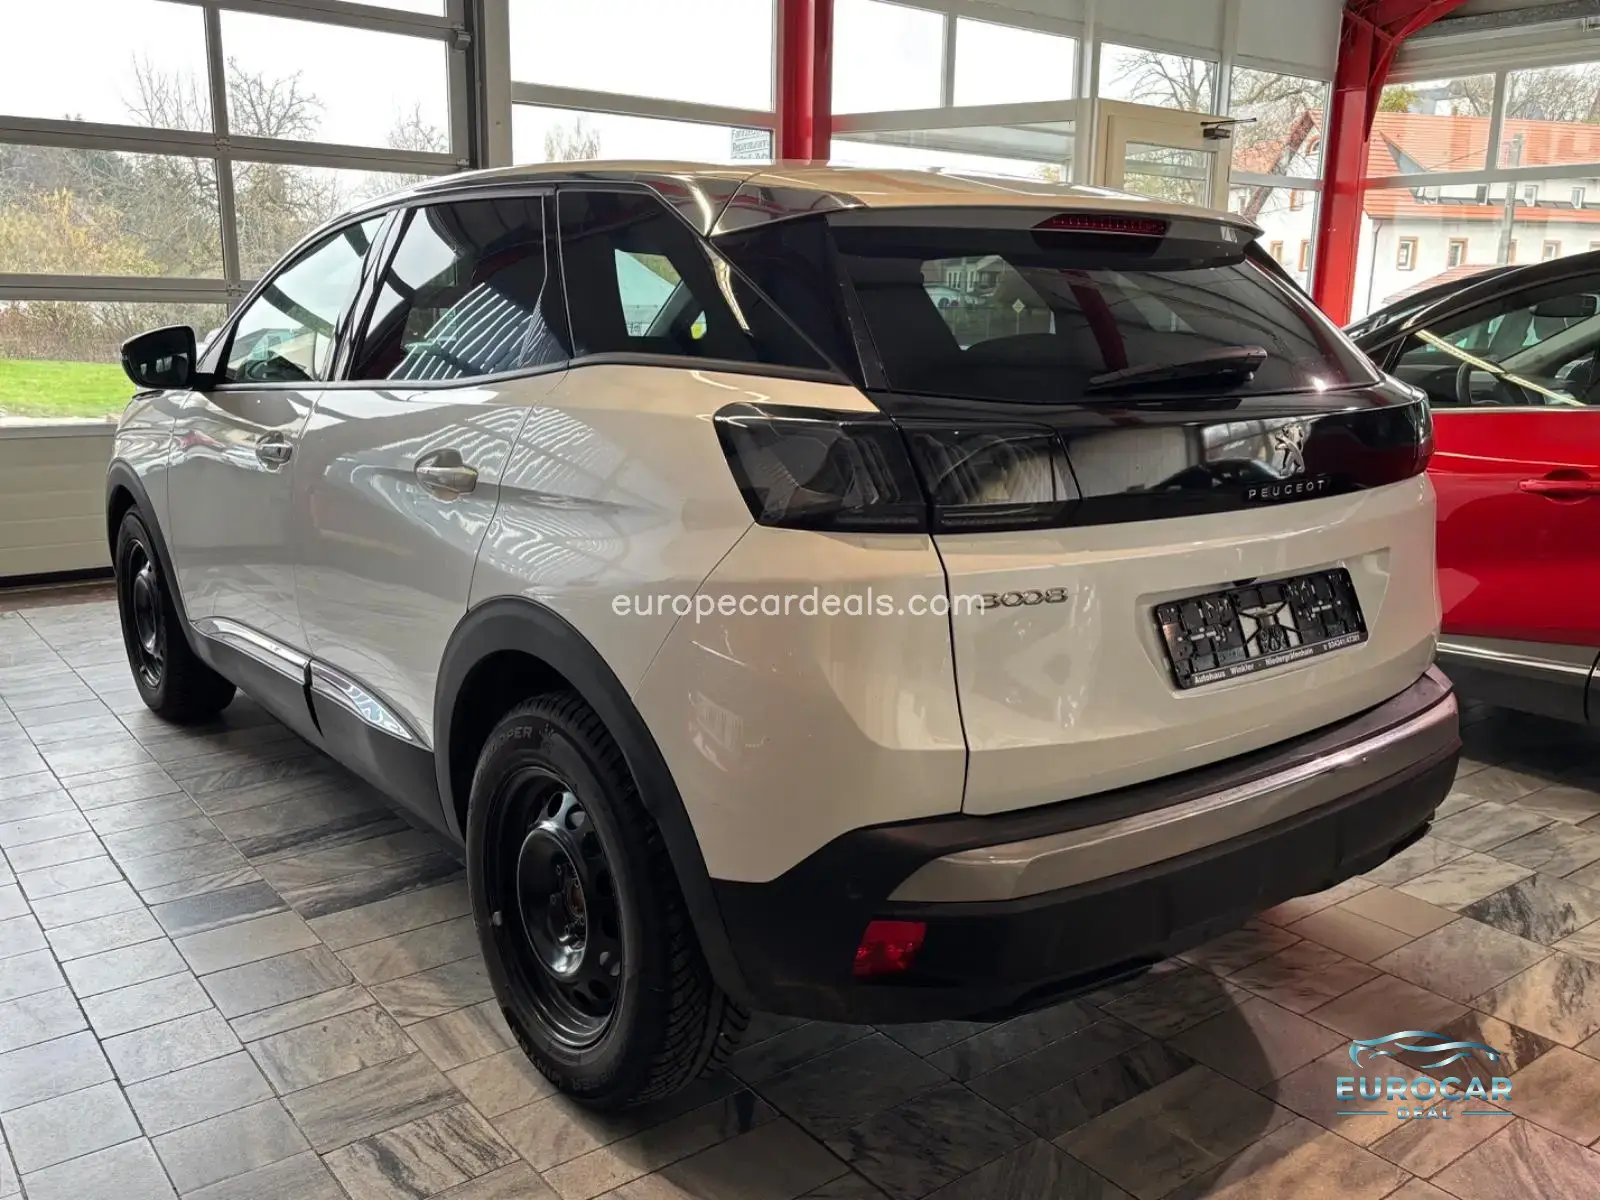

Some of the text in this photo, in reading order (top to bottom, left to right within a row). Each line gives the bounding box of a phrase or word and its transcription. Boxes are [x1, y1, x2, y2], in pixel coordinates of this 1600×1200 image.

[1248, 480, 1325, 499] PEUGEOT
[976, 587, 1068, 609] 3008
[1194, 671, 1226, 685] Autohaus
[1230, 663, 1255, 675] Winkler
